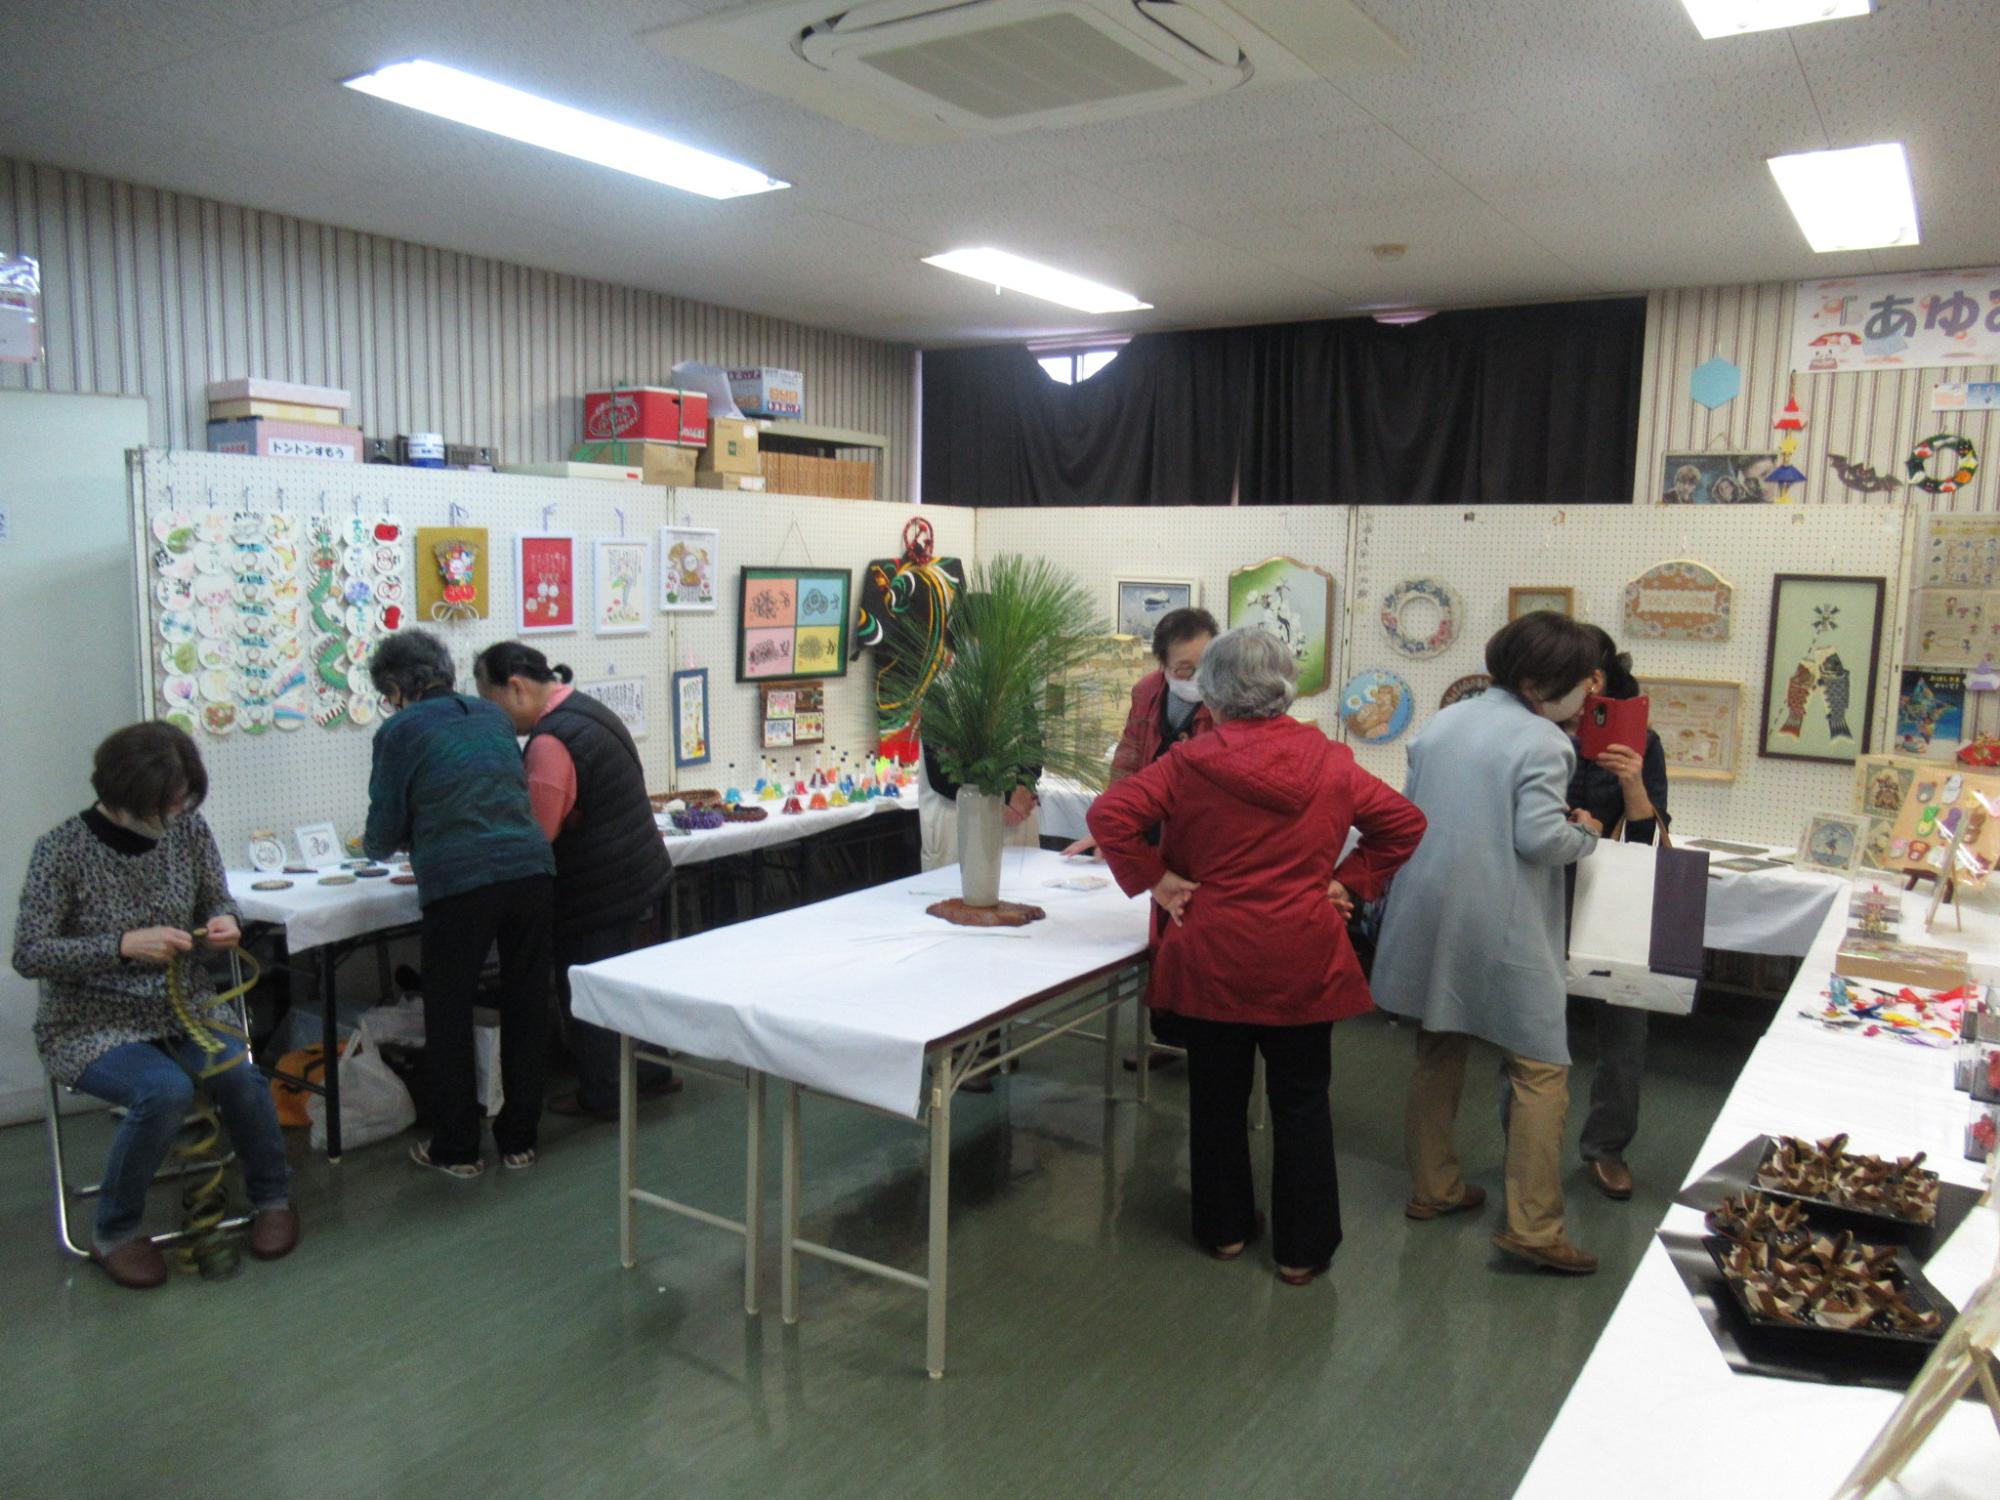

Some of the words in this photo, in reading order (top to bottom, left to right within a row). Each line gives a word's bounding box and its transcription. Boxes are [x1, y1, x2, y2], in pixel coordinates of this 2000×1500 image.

[273, 441, 345, 459] トントンすもう
